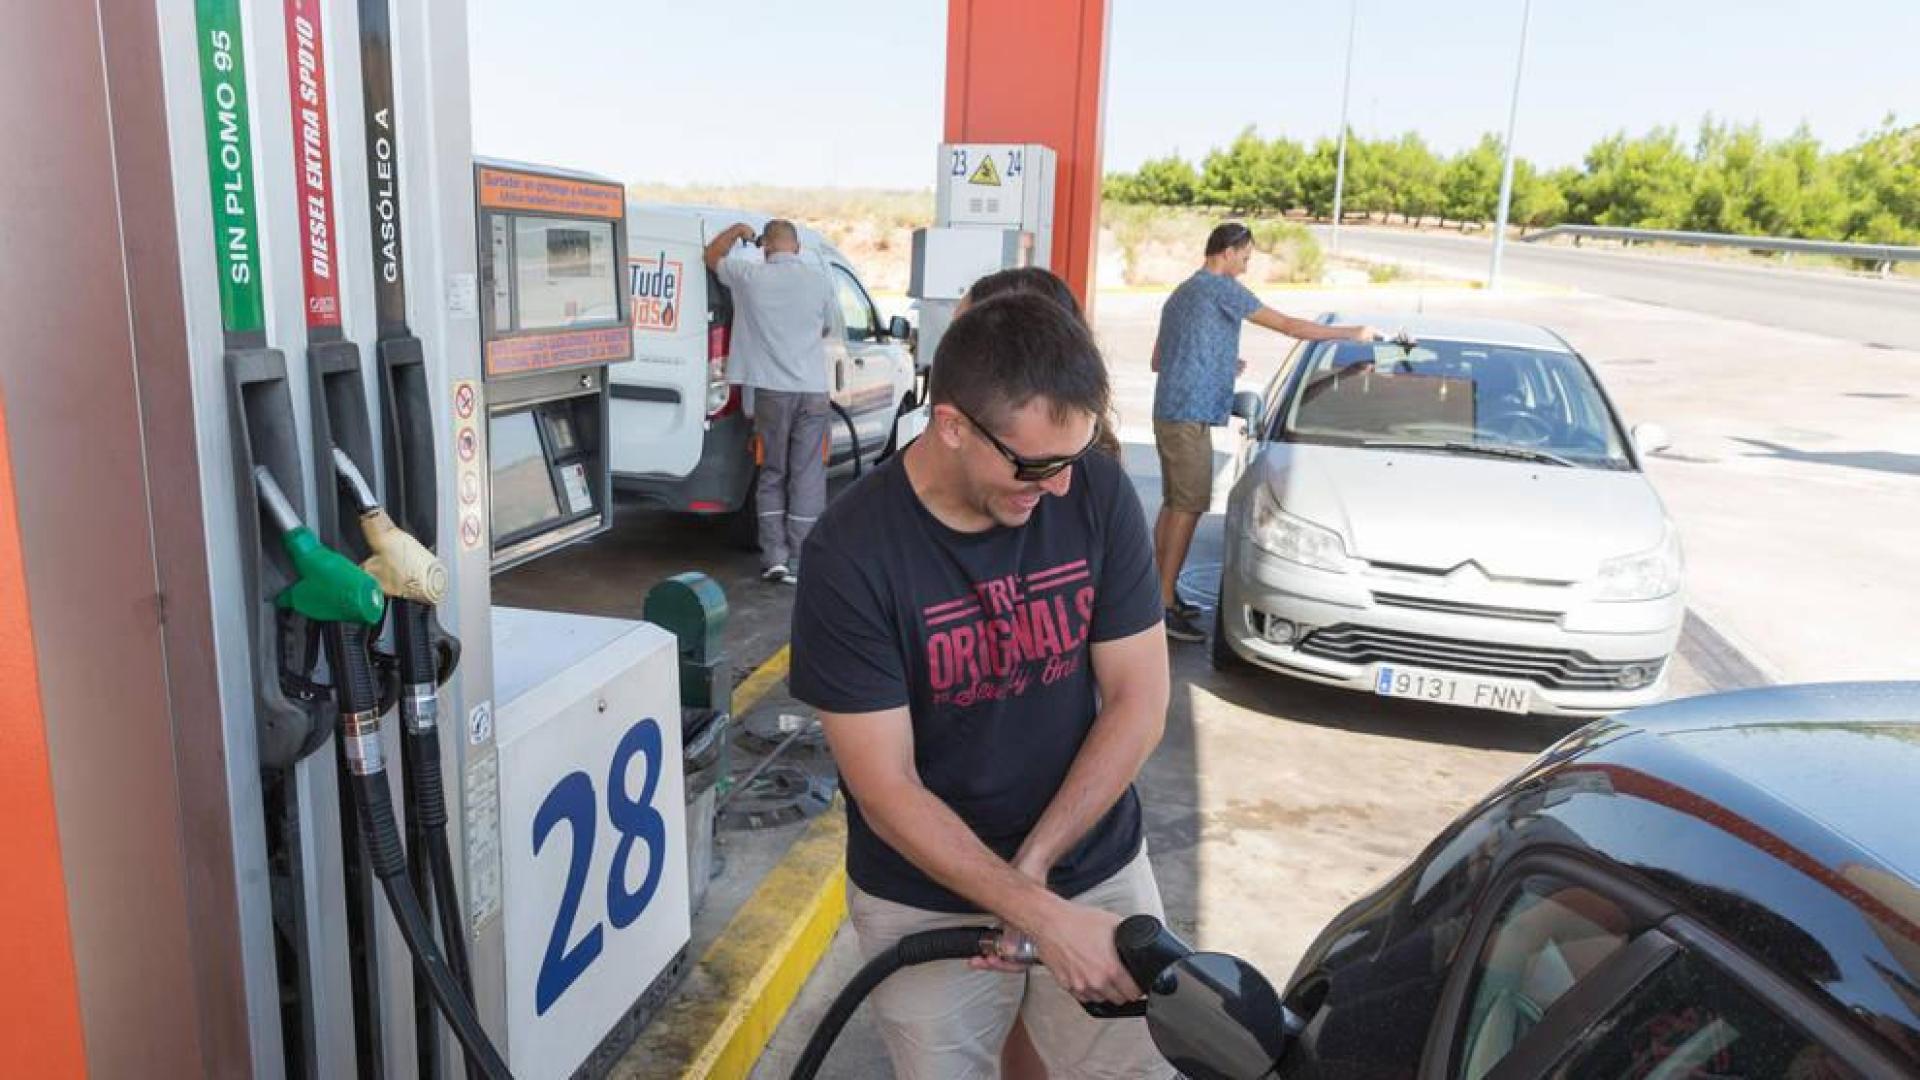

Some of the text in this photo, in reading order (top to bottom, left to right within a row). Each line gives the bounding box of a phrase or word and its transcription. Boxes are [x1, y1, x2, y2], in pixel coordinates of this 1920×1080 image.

[211, 29, 249, 284] SIN PLOMO 95
[301, 107, 324, 190] EXTRA
[951, 150, 967, 176] 23
[1007, 150, 1022, 176] 24
[374, 107, 397, 283] GASÓLEO A
[307, 196, 330, 279] DIESEL
[1395, 672, 1526, 711] 9131 FNN
[532, 717, 666, 1018] 28
